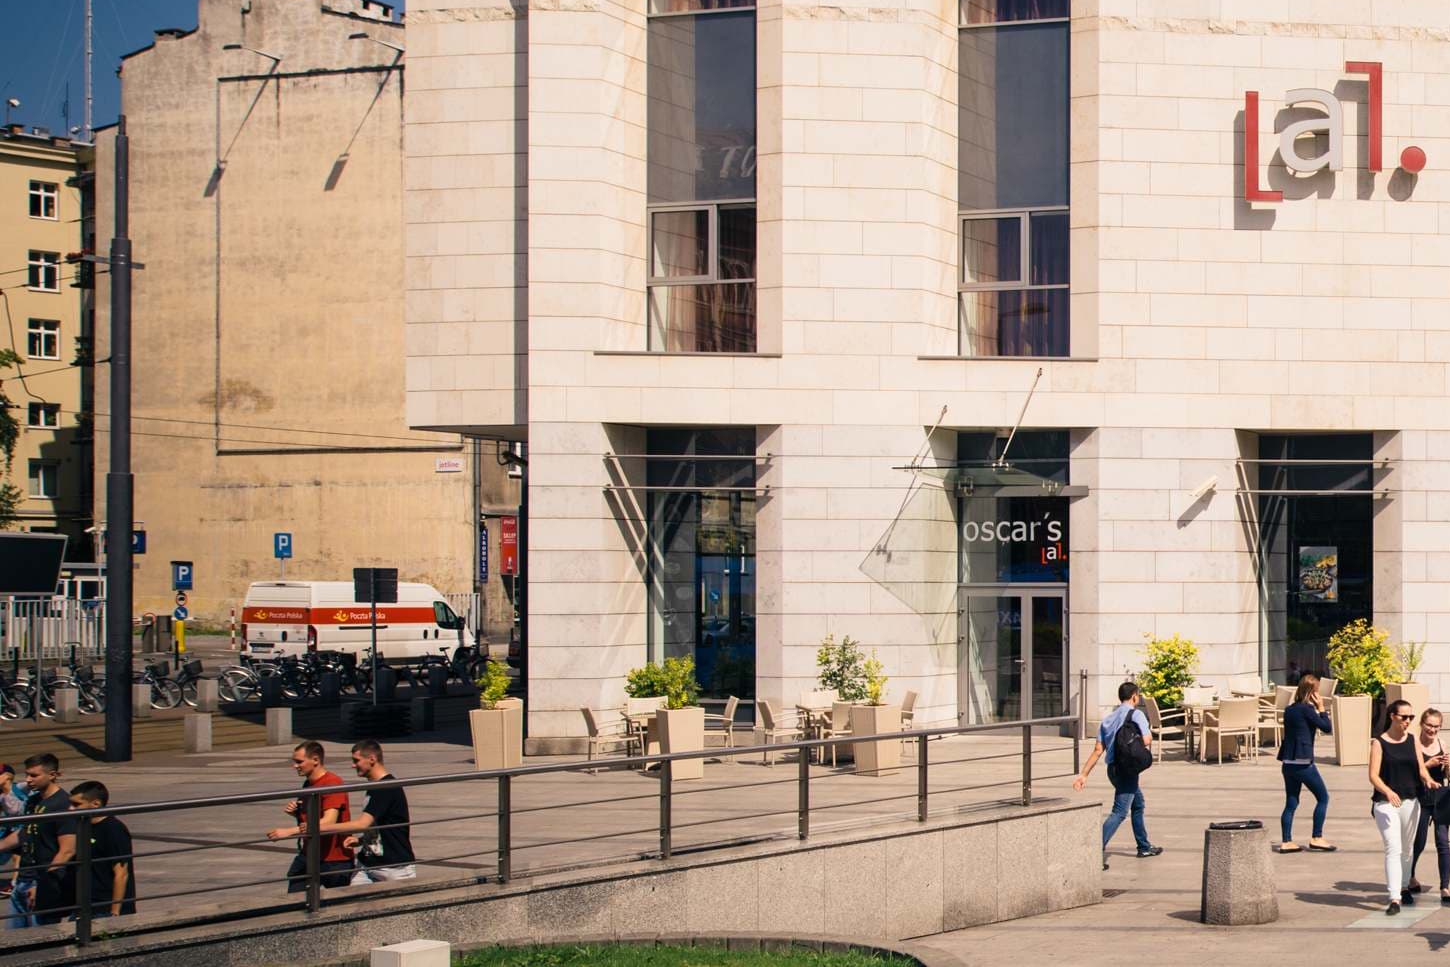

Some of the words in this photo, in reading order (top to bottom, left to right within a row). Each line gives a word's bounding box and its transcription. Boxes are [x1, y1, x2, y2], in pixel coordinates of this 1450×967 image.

[963, 512, 1062, 542] oscar's
[278, 535, 289, 551] P
[178, 565, 190, 581] P
[350, 611, 368, 620] Poczta
